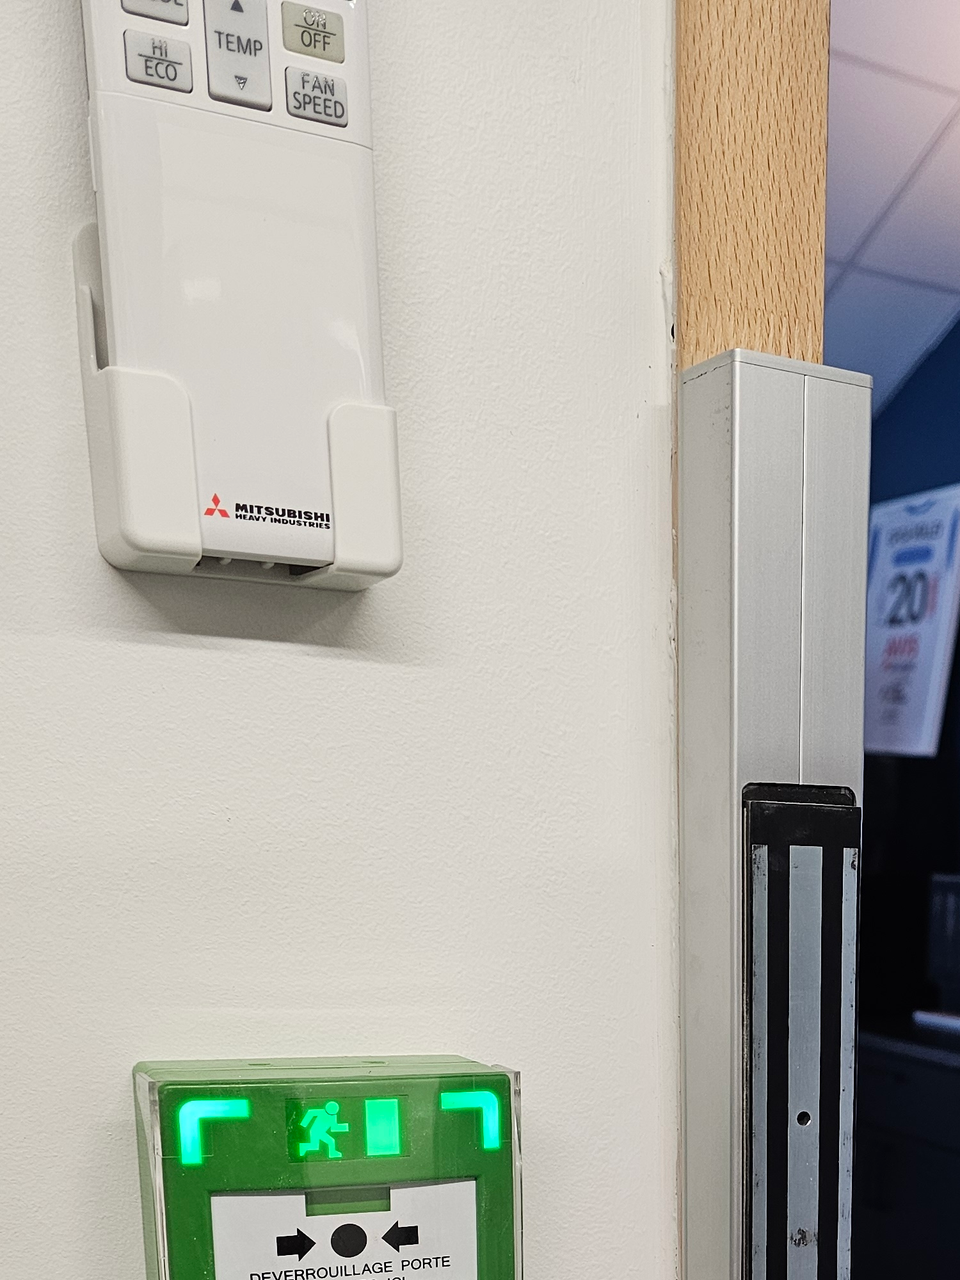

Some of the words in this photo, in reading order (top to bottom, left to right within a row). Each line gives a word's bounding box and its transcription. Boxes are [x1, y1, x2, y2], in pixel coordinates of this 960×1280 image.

[303, 9, 327, 30] ON
[214, 30, 263, 57] TEMP
[301, 30, 331, 51] OFF
[145, 59, 178, 82] ECO
[301, 72, 335, 97] FAN
[293, 91, 345, 119] SPEED
[235, 502, 331, 523] MITSUBISHI
[235, 513, 267, 523] HEAVY
[270, 517, 331, 530] INDUSTRIES
[401, 1255, 452, 1272] PORTE
